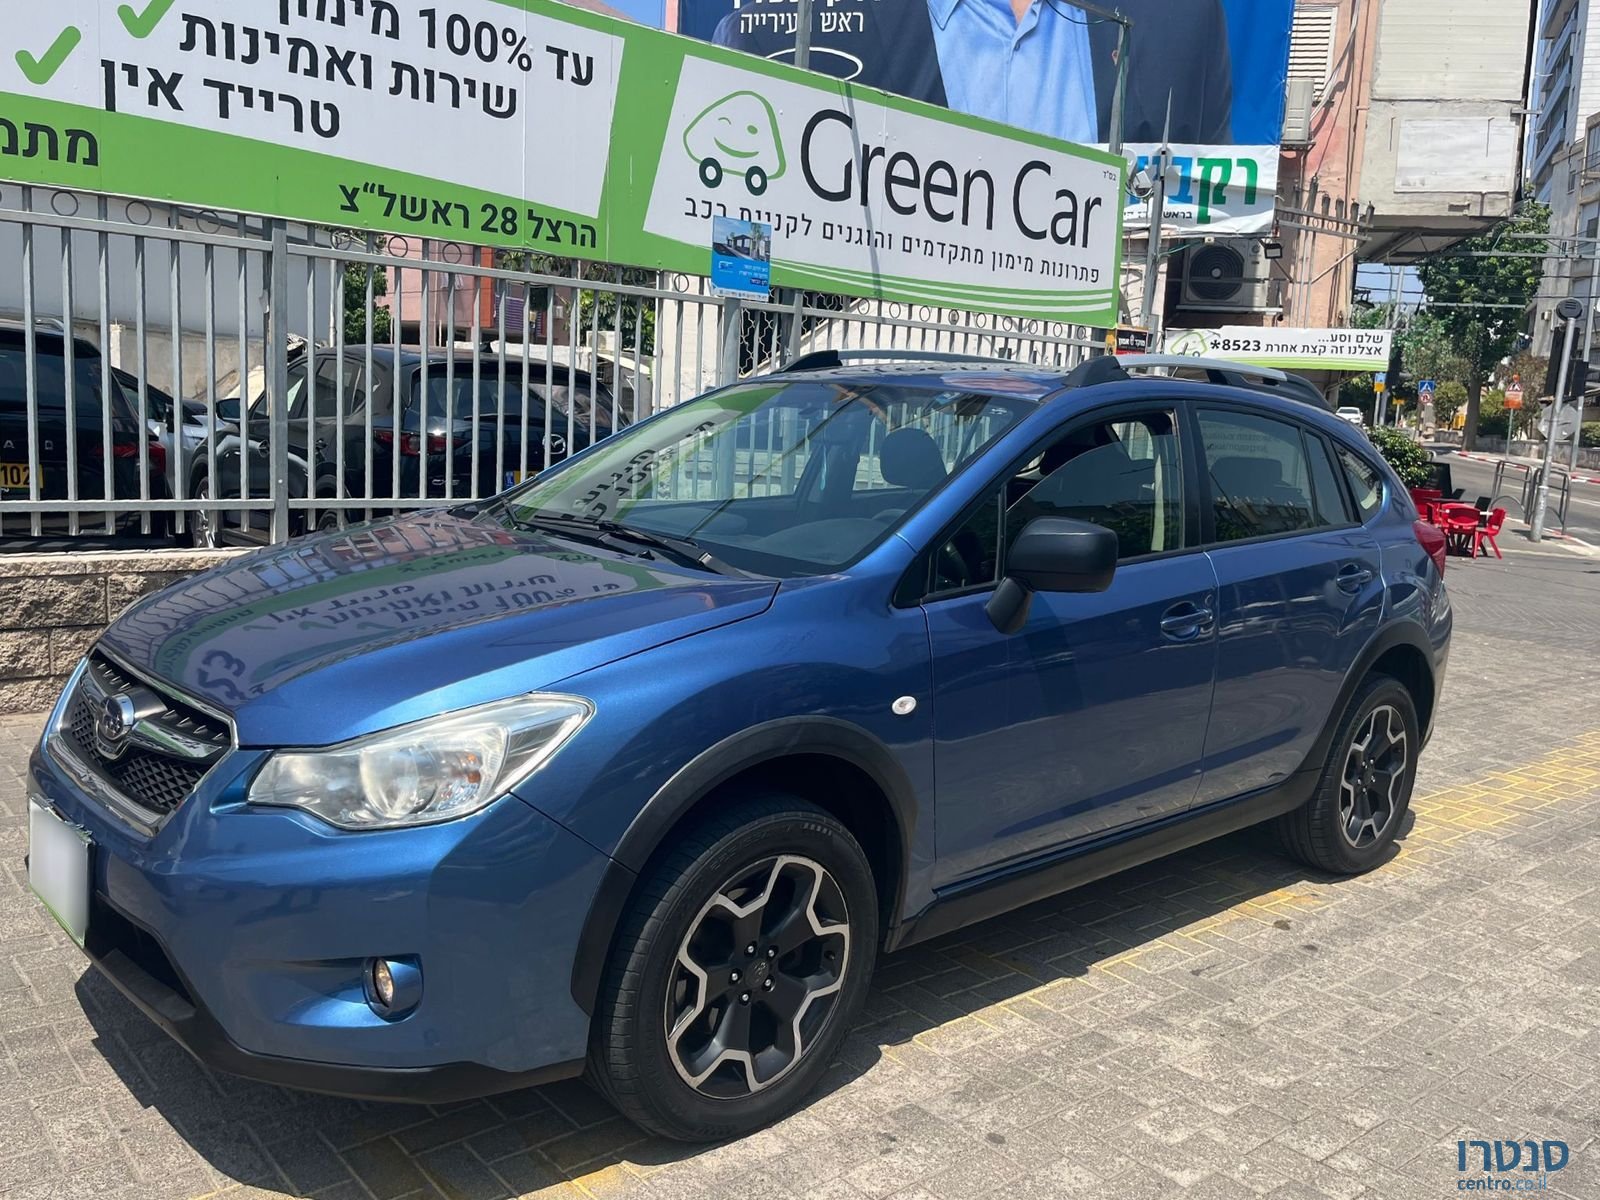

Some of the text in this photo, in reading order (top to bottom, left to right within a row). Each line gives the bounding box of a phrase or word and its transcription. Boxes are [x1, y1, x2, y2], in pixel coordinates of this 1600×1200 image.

[740, 11, 864, 34] ראש עירייה
[419, 8, 532, 72] 100%
[179, 12, 518, 119] שירות ואמינות
[546, 45, 594, 86] עד
[101, 59, 340, 138] טרייד אין
[800, 109, 995, 231] Green
[1012, 160, 1102, 248] Car
[1196, 157, 1259, 224] רק
[480, 203, 518, 236] 28
[684, 197, 727, 219] רכב
[527, 208, 597, 248] הרצל
[822, 222, 893, 249] והוגנים
[902, 235, 984, 265] מתקדמים
[992, 250, 1033, 272] מימון
[1039, 259, 1100, 283] פתרונות
[1264, 342, 1297, 353] אחרת
[1301, 344, 1327, 356] קצת
[1331, 345, 1344, 354] זה
[1348, 344, 1382, 356] אצלנו
[1356, 333, 1383, 343] שלם
